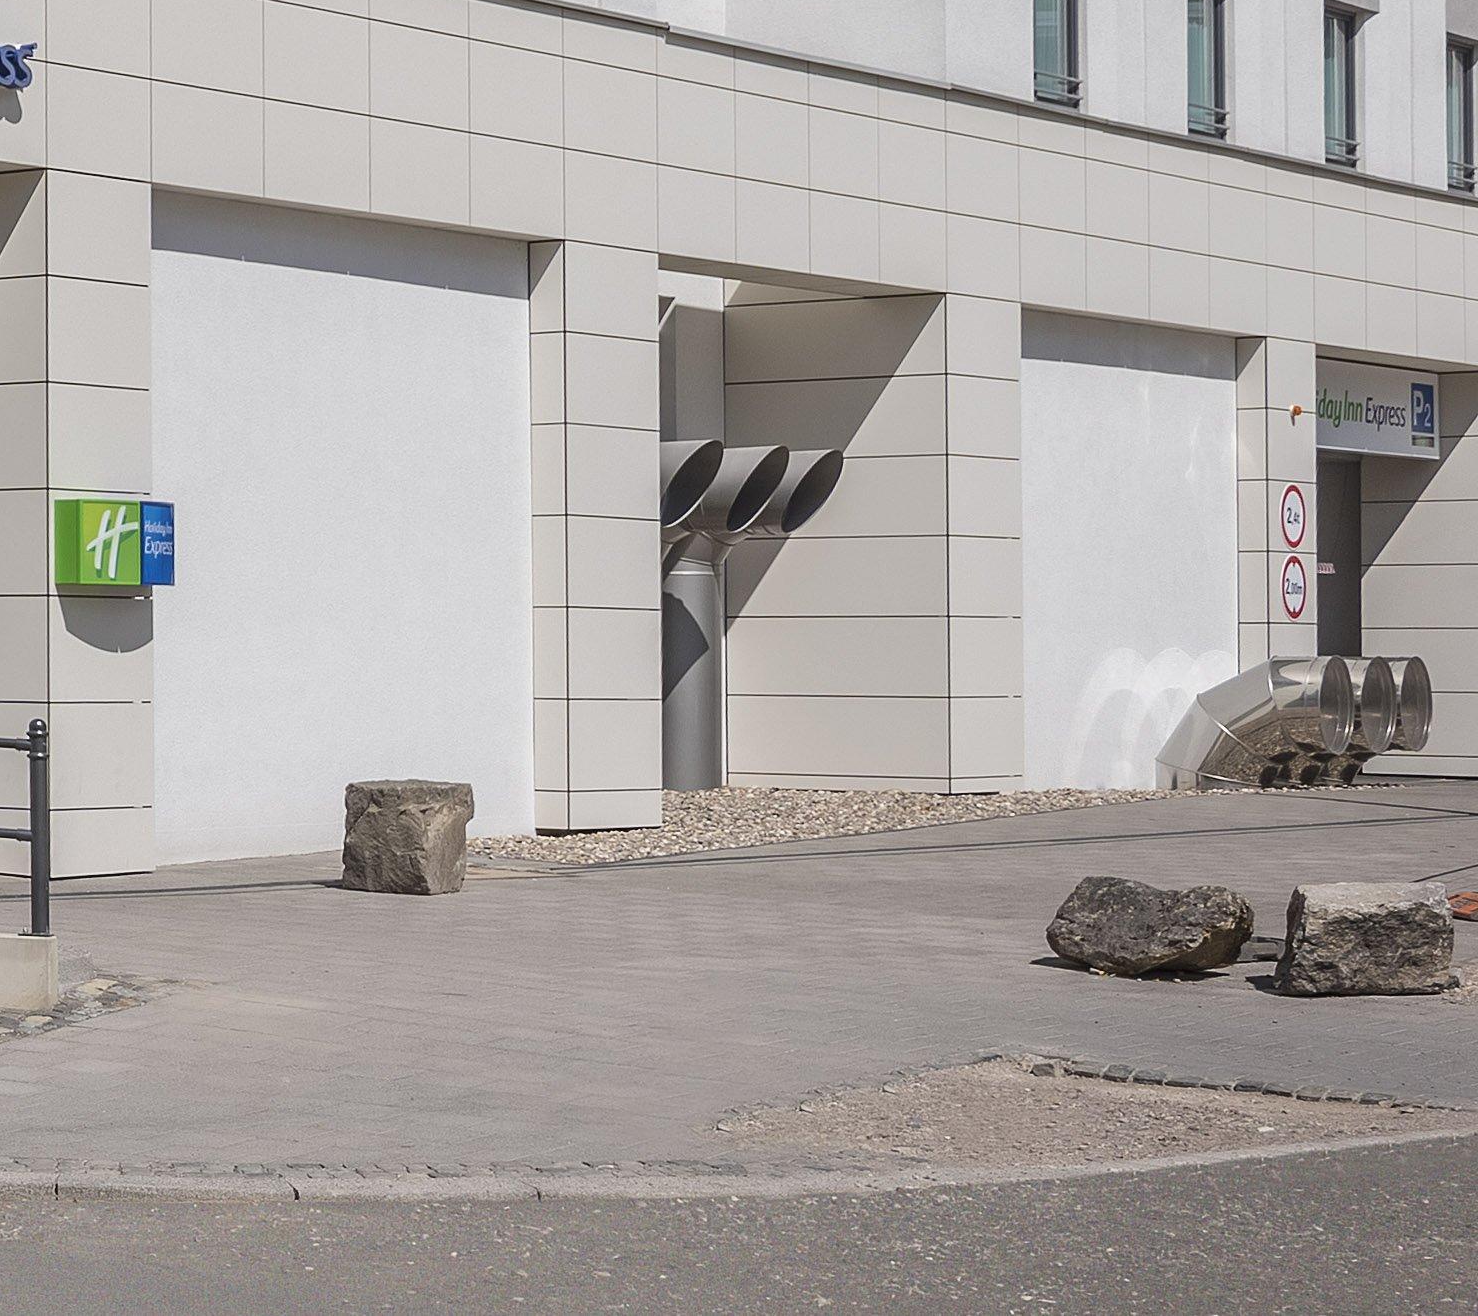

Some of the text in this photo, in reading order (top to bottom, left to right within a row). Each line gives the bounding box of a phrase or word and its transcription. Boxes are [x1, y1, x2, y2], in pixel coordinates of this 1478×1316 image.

[1343, 390, 1363, 422] Inn
[1365, 397, 1406, 431] Express
[144, 520, 166, 537] Holiday
[144, 536, 173, 559] Express
